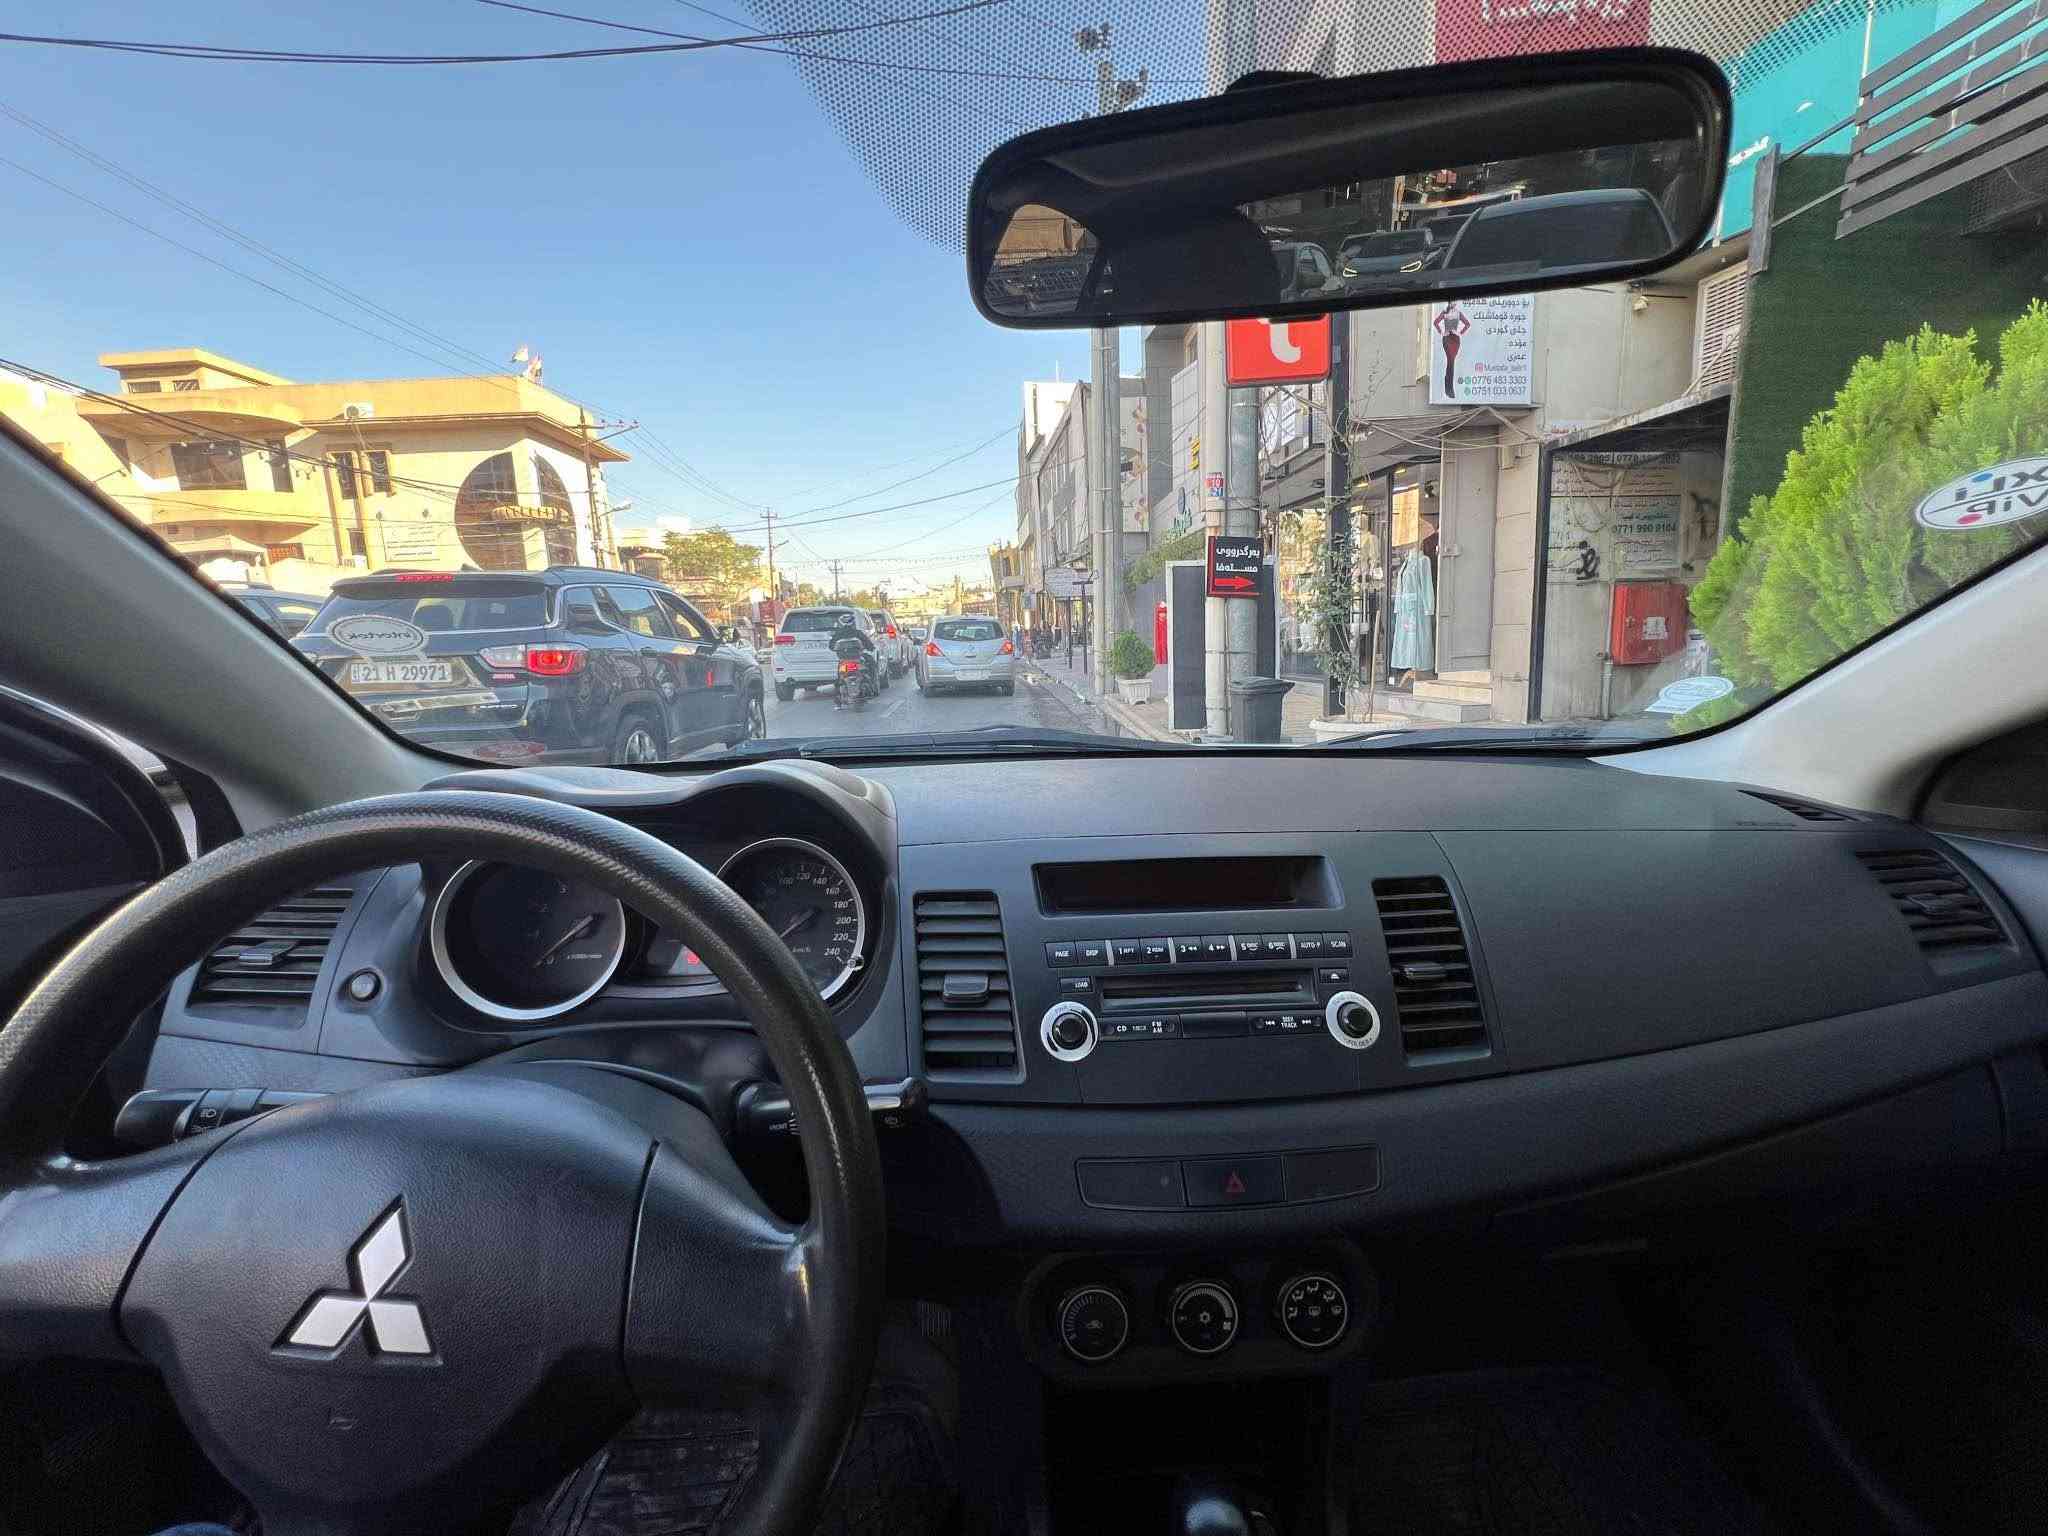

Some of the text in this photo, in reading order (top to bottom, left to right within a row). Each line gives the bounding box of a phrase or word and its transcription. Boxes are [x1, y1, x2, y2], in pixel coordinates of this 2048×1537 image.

[361, 664, 380, 681] 21
[386, 666, 396, 681] H
[402, 664, 447, 681] 29971
[834, 901, 849, 909] 180
[835, 916, 852, 926] 200
[832, 933, 849, 942] 220
[823, 947, 841, 956] 240
[1116, 1025, 1127, 1033] CD
